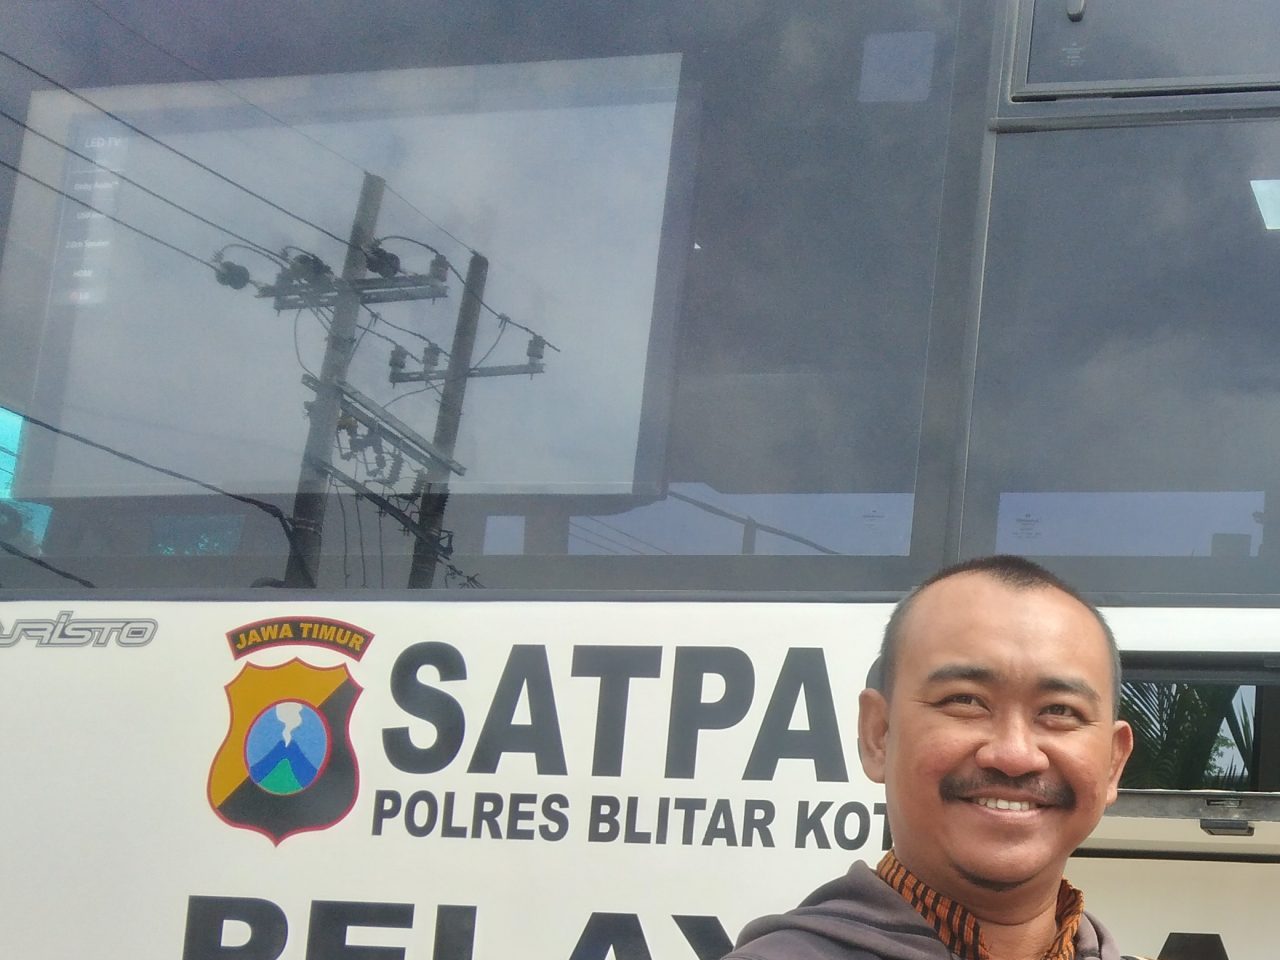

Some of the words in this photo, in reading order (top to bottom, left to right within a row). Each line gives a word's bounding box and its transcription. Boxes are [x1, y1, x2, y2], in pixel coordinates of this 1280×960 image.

[236, 623, 294, 650] JAWA
[299, 622, 365, 652] TIMUR
[382, 641, 882, 783] SATPA
[371, 790, 569, 841] POLRES
[588, 795, 776, 849] BLITAR
[794, 800, 894, 852] KOT
